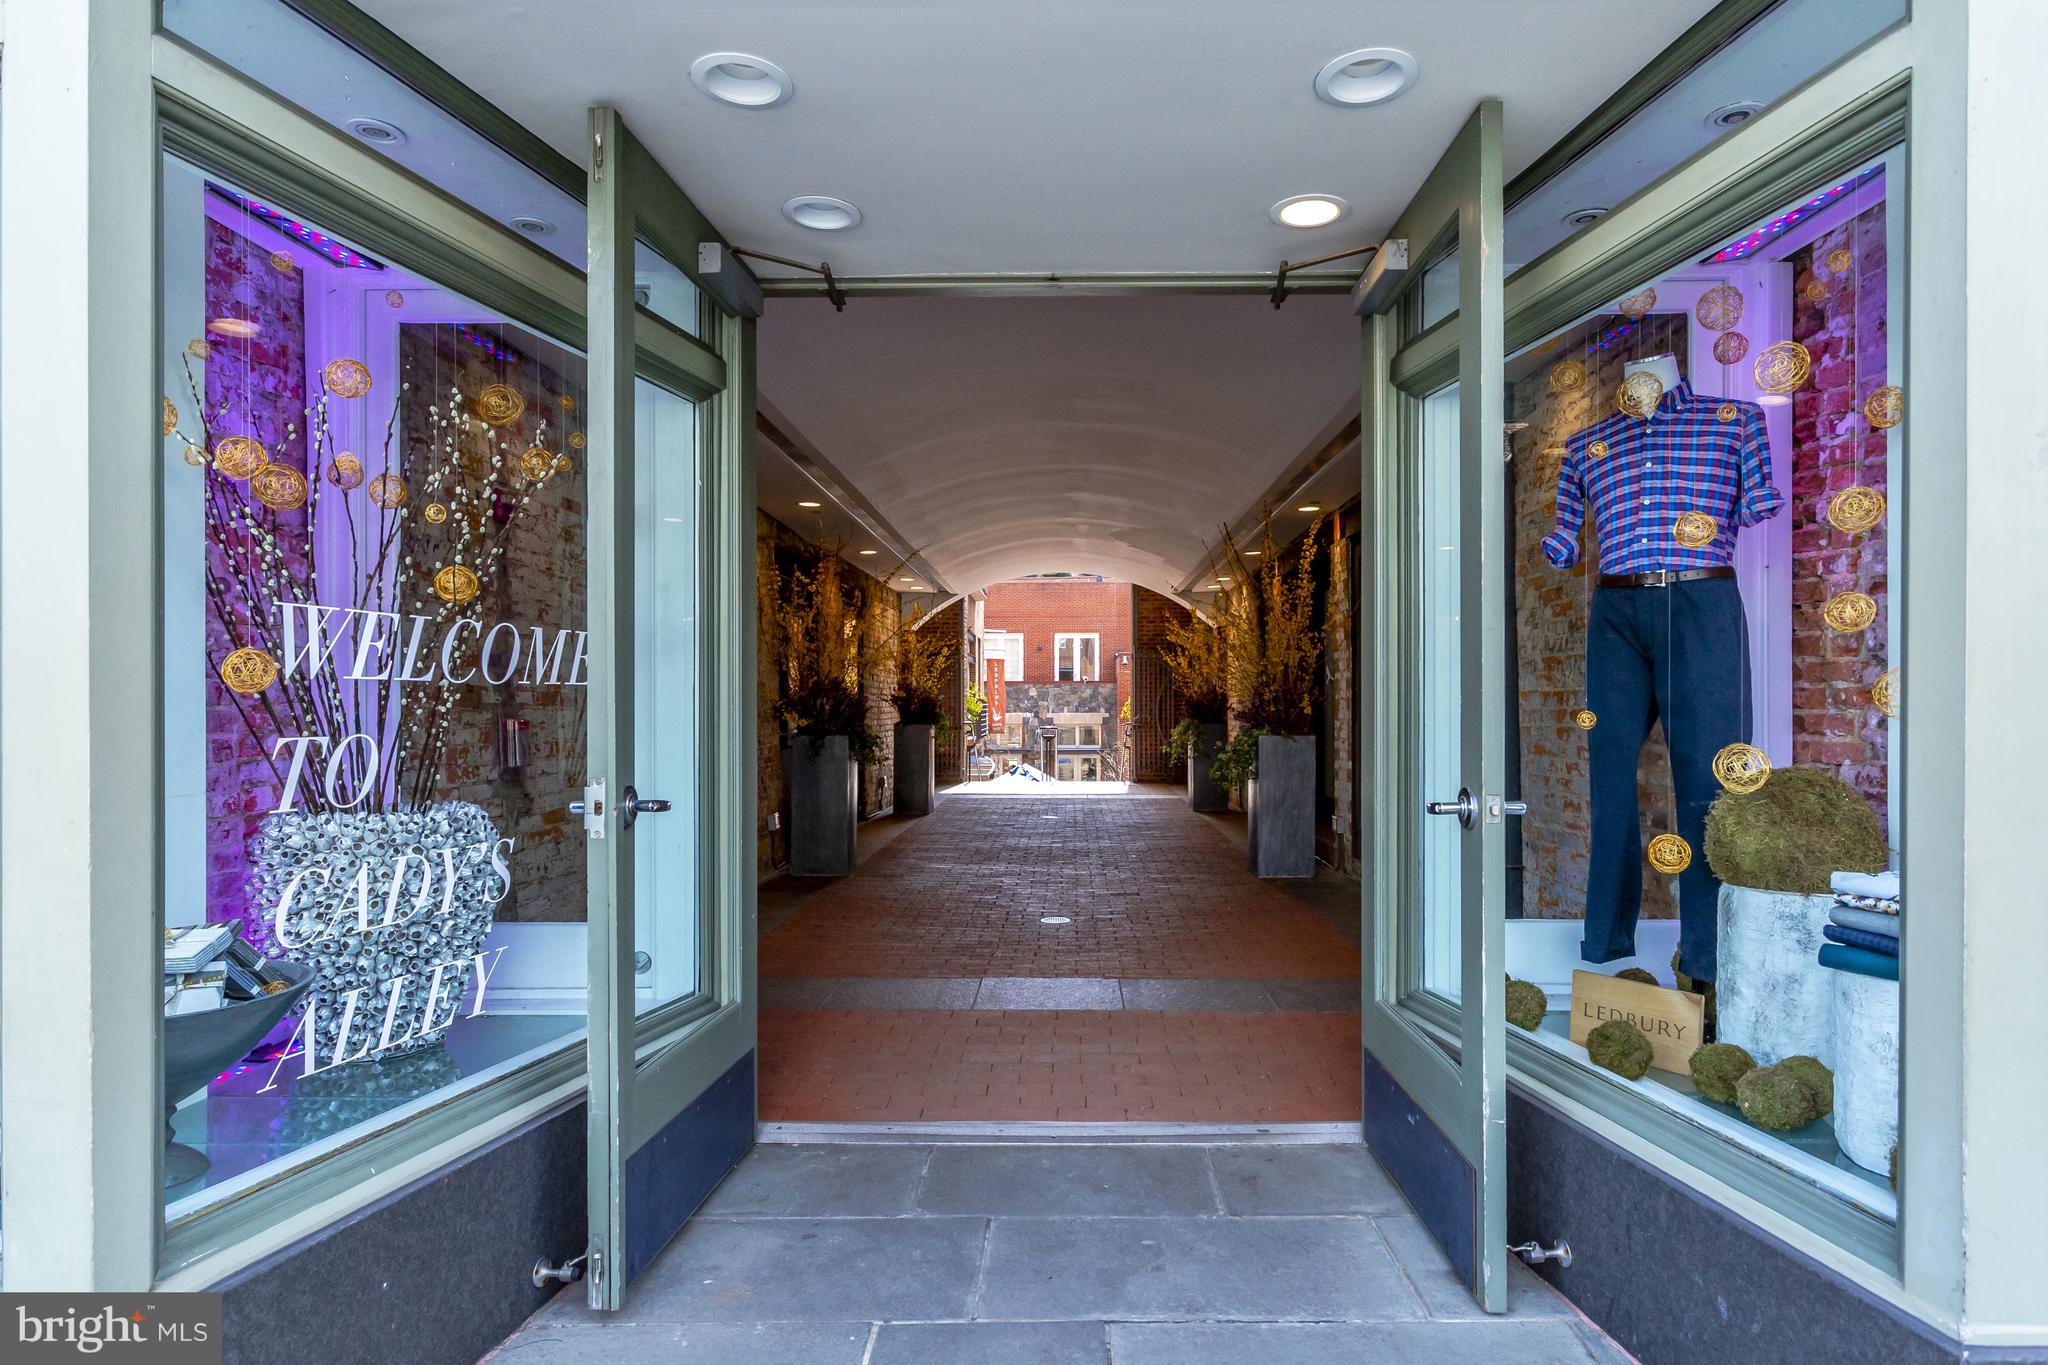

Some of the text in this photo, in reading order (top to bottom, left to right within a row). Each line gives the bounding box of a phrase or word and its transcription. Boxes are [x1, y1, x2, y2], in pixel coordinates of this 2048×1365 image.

[268, 733, 380, 814] TO
[274, 838, 515, 949] CADY'S
[255, 946, 509, 1094] ALLEY
[1583, 1002, 1686, 1040] LEDBURY
